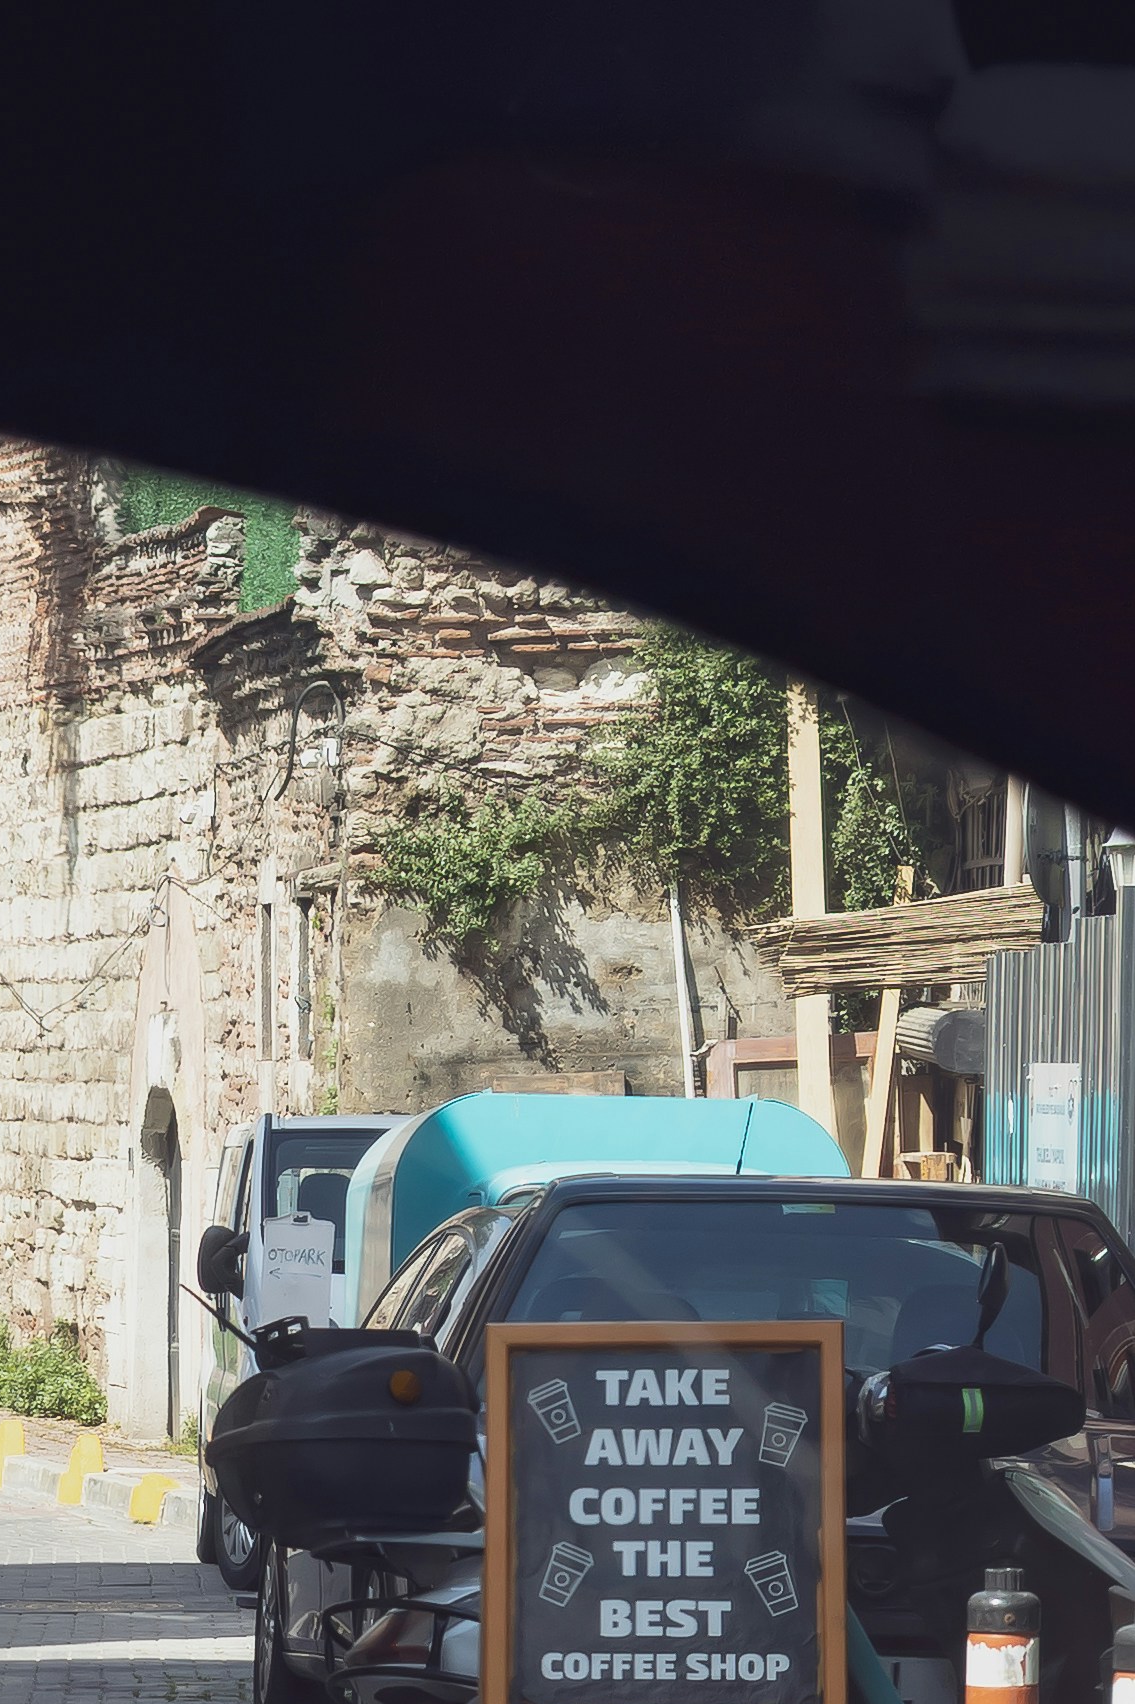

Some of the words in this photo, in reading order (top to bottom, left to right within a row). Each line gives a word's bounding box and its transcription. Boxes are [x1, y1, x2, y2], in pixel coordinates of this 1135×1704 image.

[268, 1248, 326, 1266] OTOPARK
[596, 1369, 730, 1406] TAKE
[584, 1428, 744, 1466] AWAY
[568, 1488, 760, 1526] COFFEE
[612, 1541, 714, 1577] THE
[599, 1599, 732, 1637] BEST
[541, 1652, 676, 1681] COFFEE
[685, 1652, 790, 1681] SHOP
